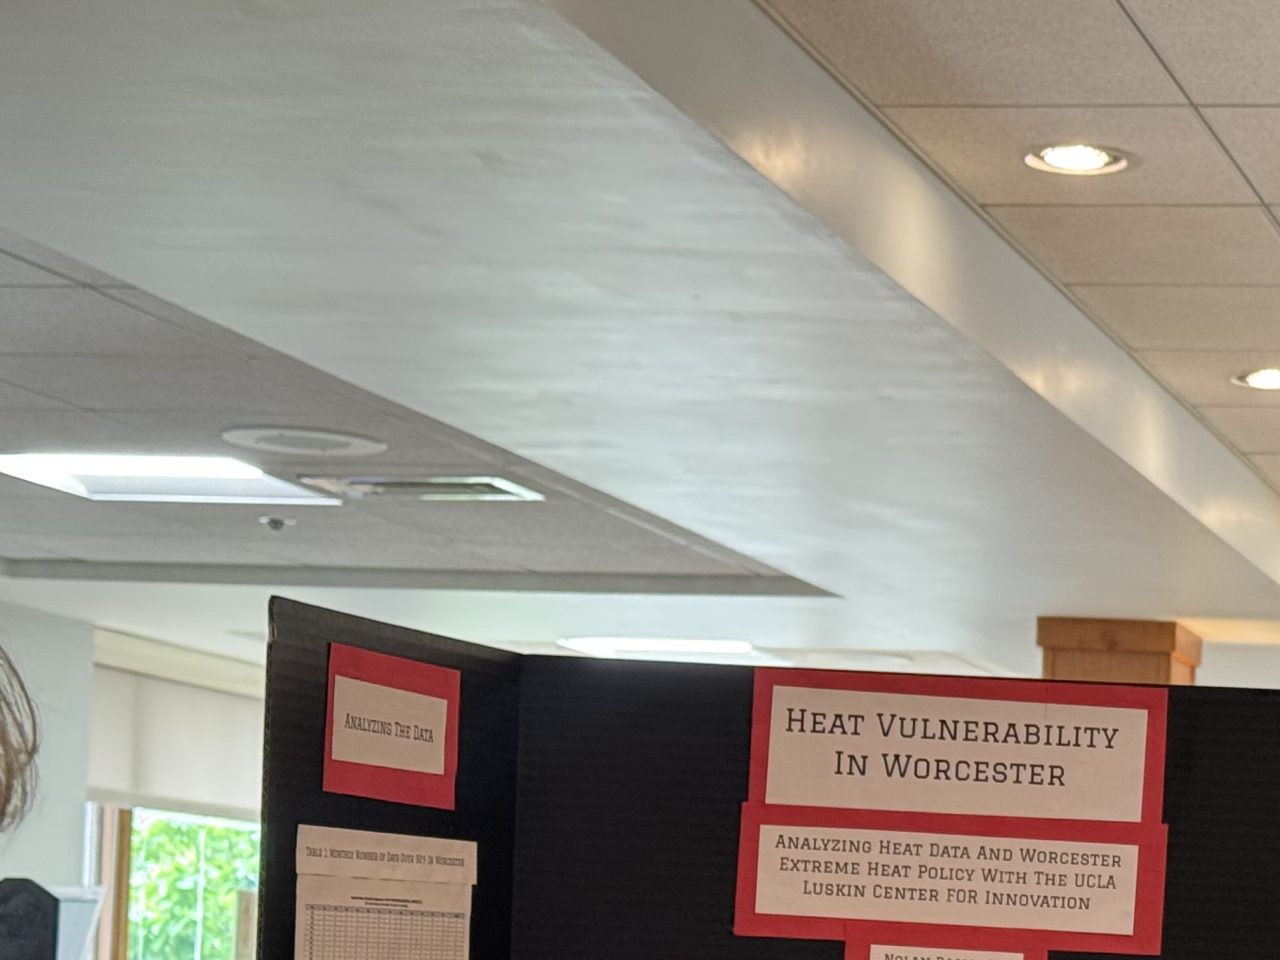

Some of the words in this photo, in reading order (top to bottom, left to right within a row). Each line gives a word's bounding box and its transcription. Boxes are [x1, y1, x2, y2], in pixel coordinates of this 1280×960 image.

[345, 713, 392, 736] ANALYZING
[394, 722, 411, 739] THE
[413, 725, 434, 743] DATA
[785, 708, 864, 736] HEAT
[877, 713, 1120, 750] VULNERABILITY
[834, 751, 868, 776] IN
[882, 754, 1066, 787] WORCESTER
[775, 834, 872, 854] ANALYZING
[879, 840, 923, 857] HEAT
[929, 843, 970, 859] DATA
[977, 845, 1013, 862] AND
[1020, 848, 1122, 868] WORCESTER
[779, 857, 860, 875] EXTREME
[867, 861, 910, 878] HEAT
[917, 865, 975, 881] POLICY
[981, 868, 1027, 885] WITH
[1034, 871, 1068, 887] THE
[1073, 873, 1117, 890] UCLA
[802, 880, 866, 897] LUSKIN
[872, 884, 940, 902] CENTER
[946, 888, 978, 904] FOR
[984, 890, 1091, 910] INNOVATION
